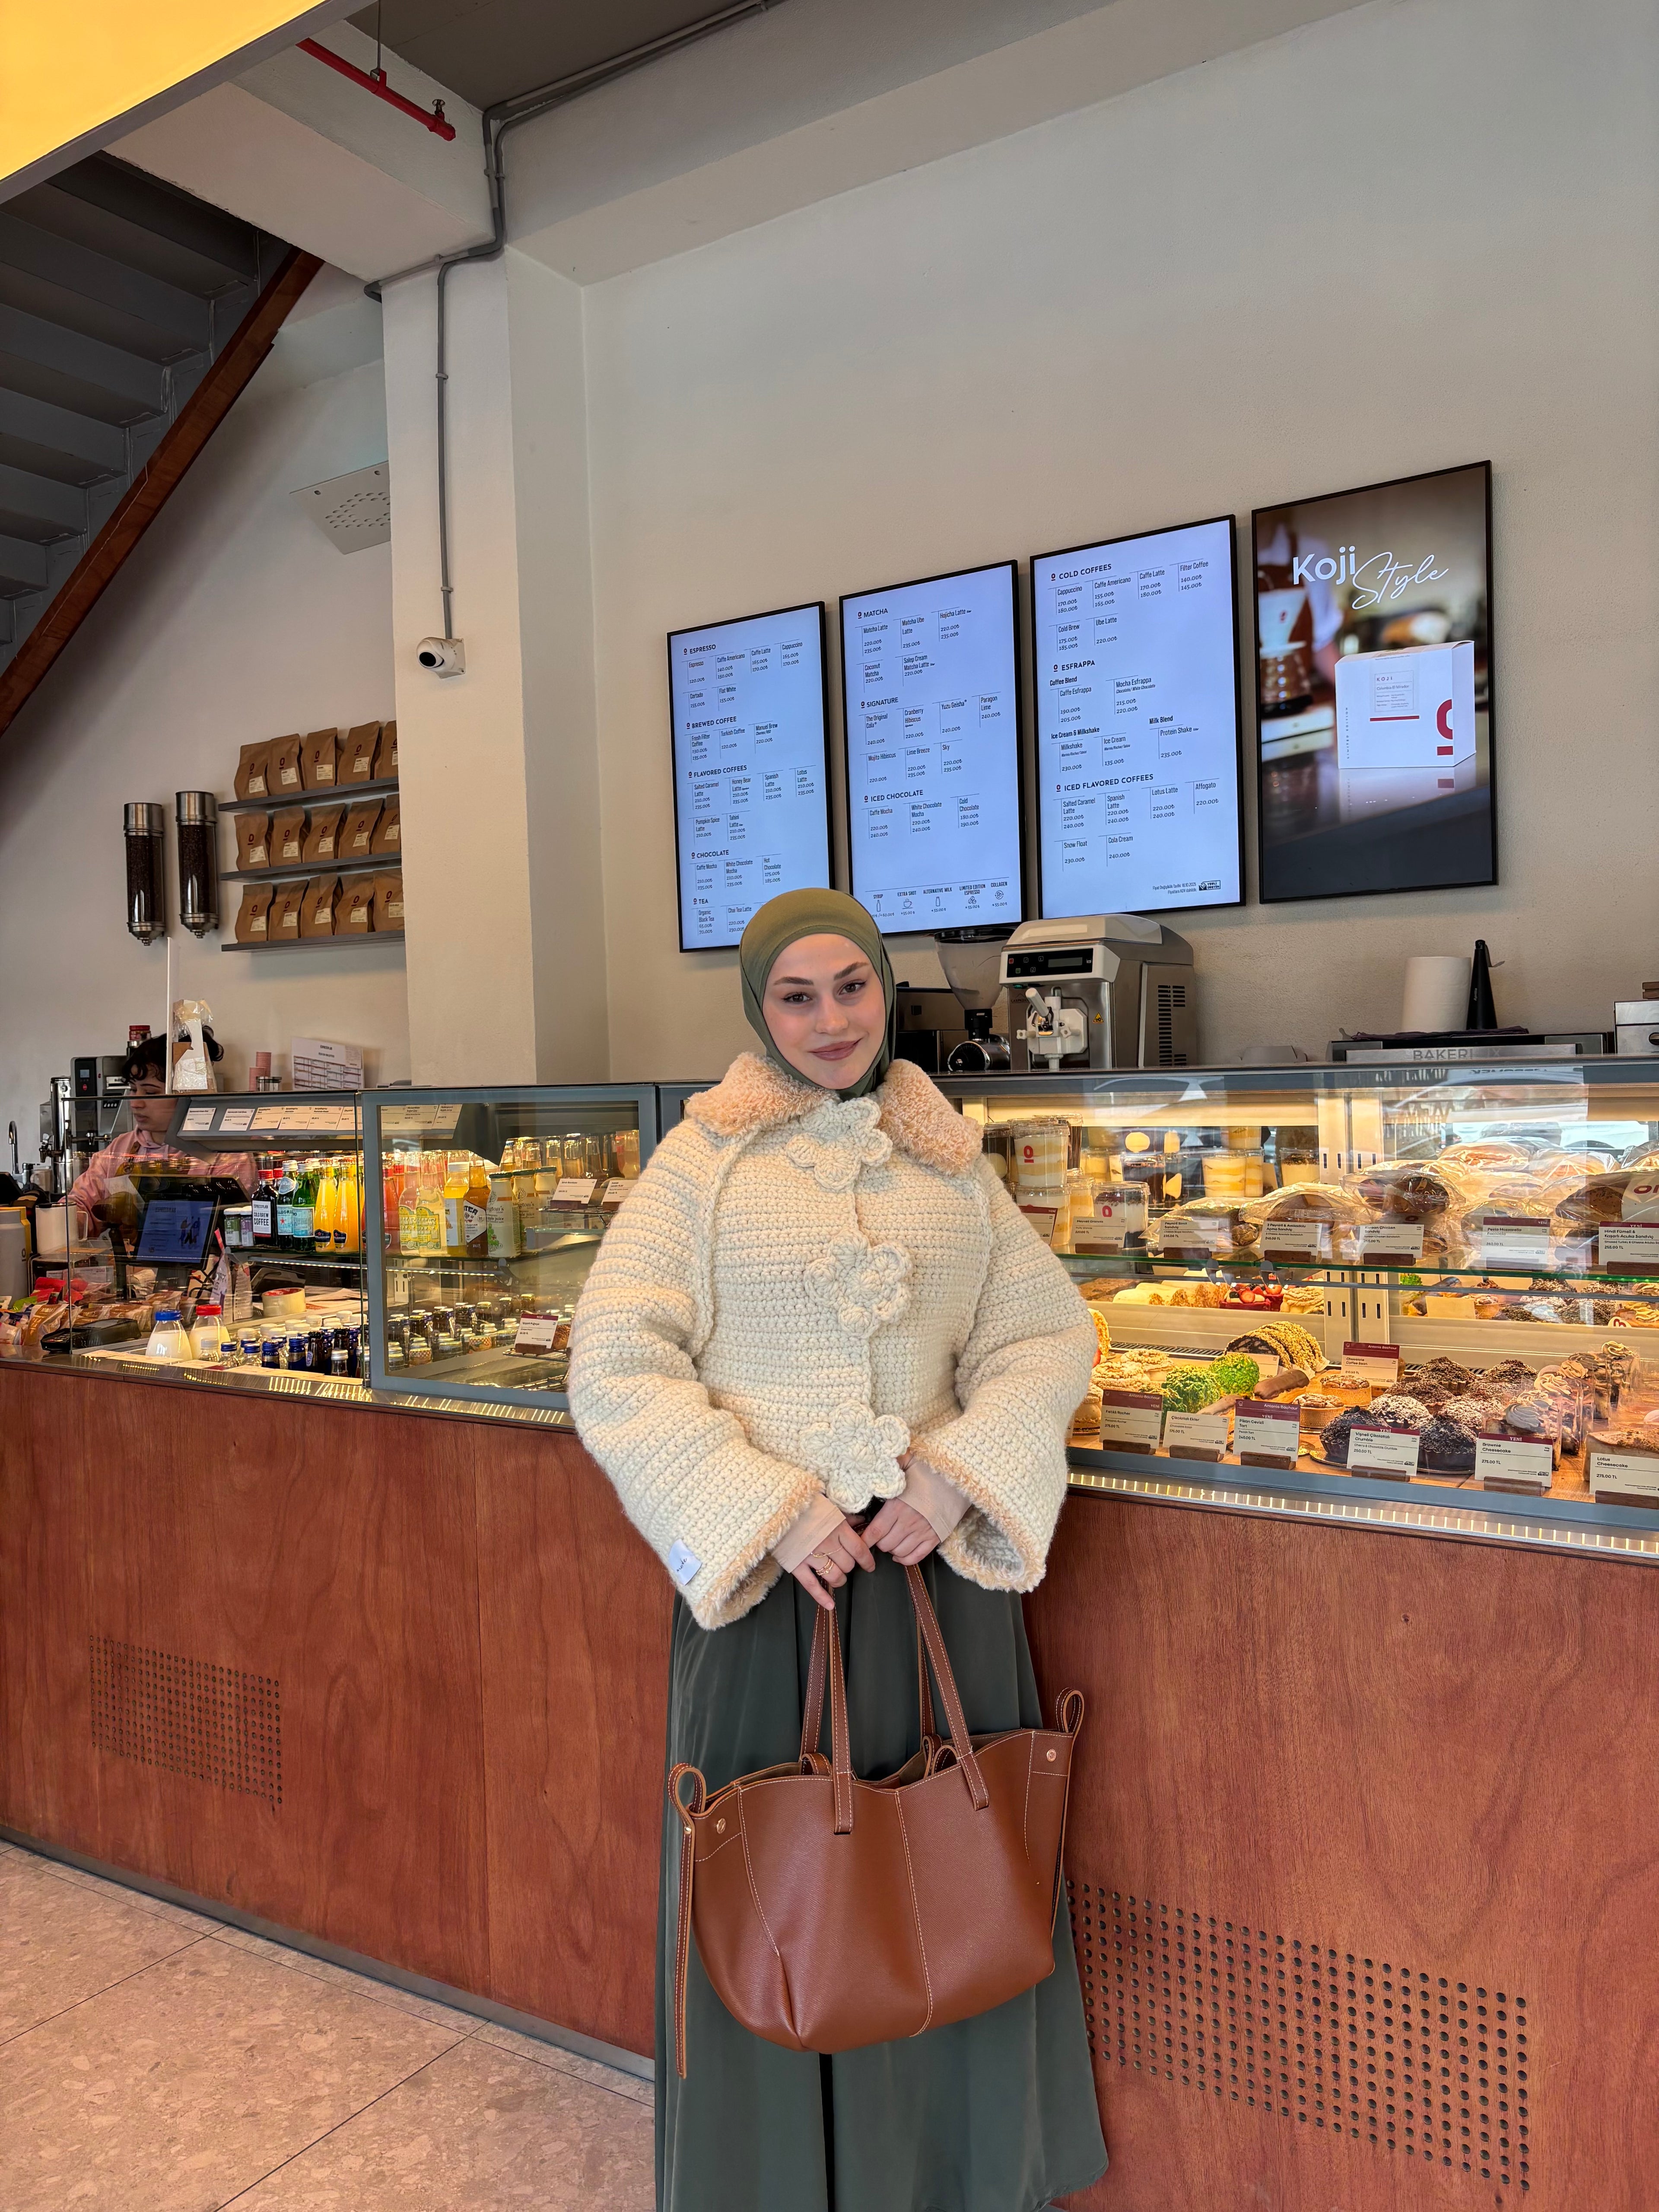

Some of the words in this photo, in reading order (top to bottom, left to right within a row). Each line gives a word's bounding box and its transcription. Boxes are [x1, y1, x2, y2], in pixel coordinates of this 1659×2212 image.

[1059, 571, 1078, 579] COLD
[1081, 563, 1112, 575] COFFEES
[1180, 563, 1192, 572] Filter
[1193, 560, 1208, 569] Coffee
[1152, 569, 1165, 577] Latte
[1293, 545, 1356, 585] Koji
[1352, 552, 1449, 610] Style
[1107, 577, 1131, 587] Americano
[1057, 585, 1082, 596] Cappuccino
[864, 608, 888, 618] MATCHA
[690, 644, 716, 654] ESPRESSO
[782, 642, 803, 650] Cappuccino
[1062, 660, 1095, 671] ESFRAPPA
[1131, 677, 1151, 686] Esfrappa
[1072, 686, 1091, 696] Esfrappa
[867, 697, 899, 707] SIGNATURE
[692, 720, 714, 728] BREWED
[716, 716, 737, 725] COFFEE
[1077, 727, 1100, 735] Milkshake
[694, 769, 721, 777] FLAVORED
[723, 765, 747, 773] COFFEES
[1083, 779, 1119, 789] FLAVORED
[1122, 774, 1153, 785] COFFEES
[1195, 782, 1216, 790] Affogato
[887, 790, 923, 800] CHOCOLATE
[1107, 794, 1125, 802] Spanish
[696, 850, 729, 858] CHOCOLATE
